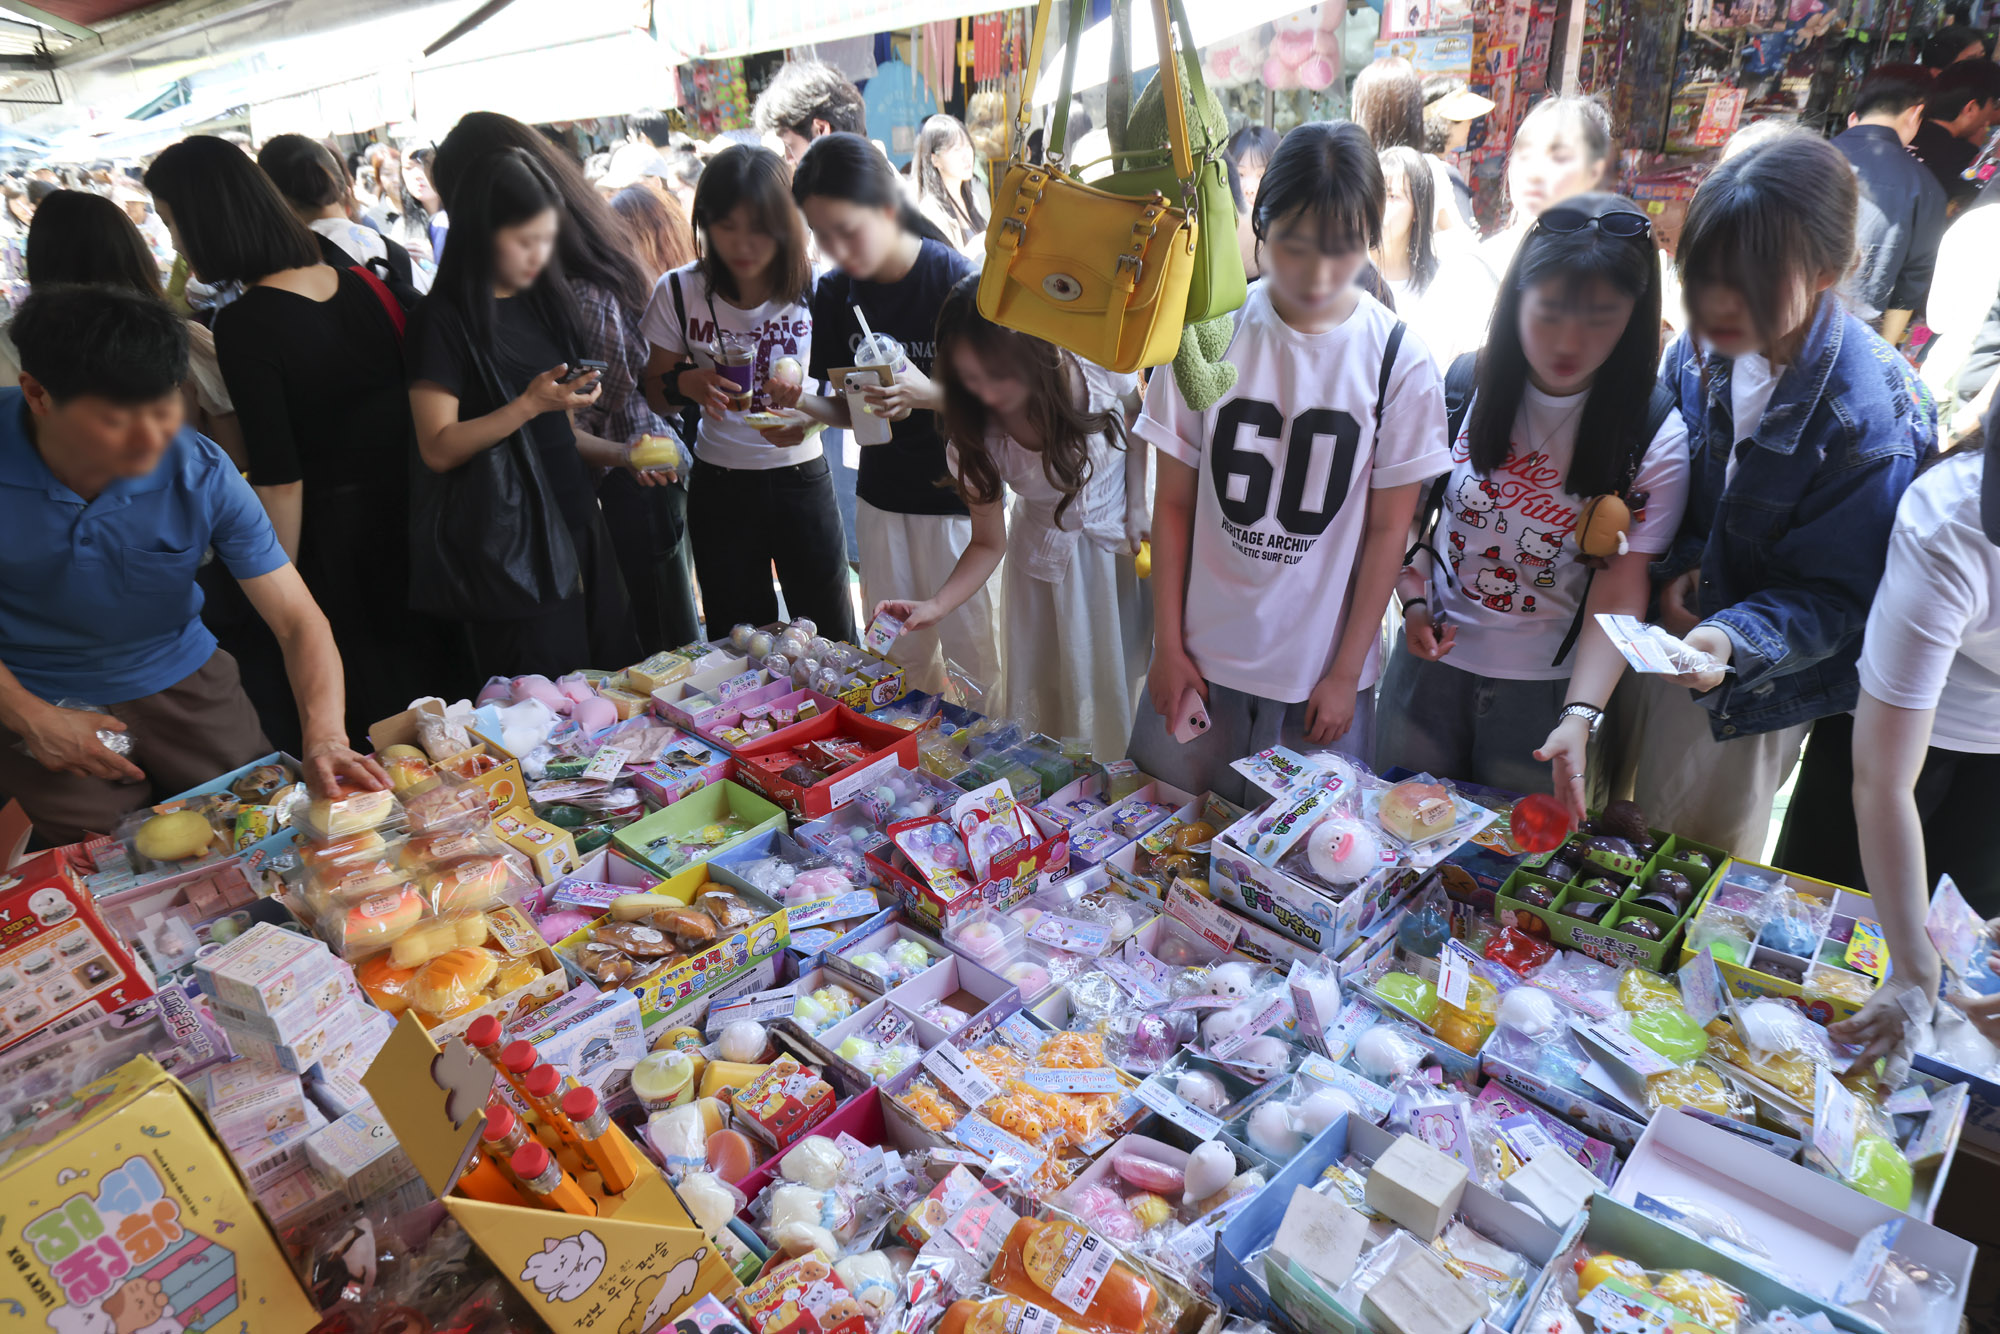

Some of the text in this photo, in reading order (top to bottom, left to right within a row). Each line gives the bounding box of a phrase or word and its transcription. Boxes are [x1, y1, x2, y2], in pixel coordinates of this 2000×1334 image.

[1211, 397, 1361, 536] 60
[1495, 481, 1577, 538] Kitty
[1221, 516, 1265, 548] HERITAGE
[1232, 540, 1259, 560] ATHLETIC
[1261, 551, 1282, 563] SURF
[982, 877, 1012, 904] 힐링
[1203, 929, 1213, 938] 14
[1239, 883, 1275, 916] 말랑
[1272, 905, 1321, 944] 빵쭉이
[677, 951, 750, 998] 고무야구공
[692, 948, 723, 972] 안전
[967, 1122, 1030, 1166] 미니물고기 말랑이
[95, 1155, 184, 1266] 박스
[24, 1192, 130, 1307] 랜덤
[1062, 1231, 1082, 1257] 스퀴시
[1083, 1236, 1096, 1249] 14
[8, 1246, 55, 1307] LUCKY BOX
[606, 1277, 636, 1302] 우드
[635, 1242, 670, 1271] 펜슬
[1025, 1306, 1037, 1319] 14
